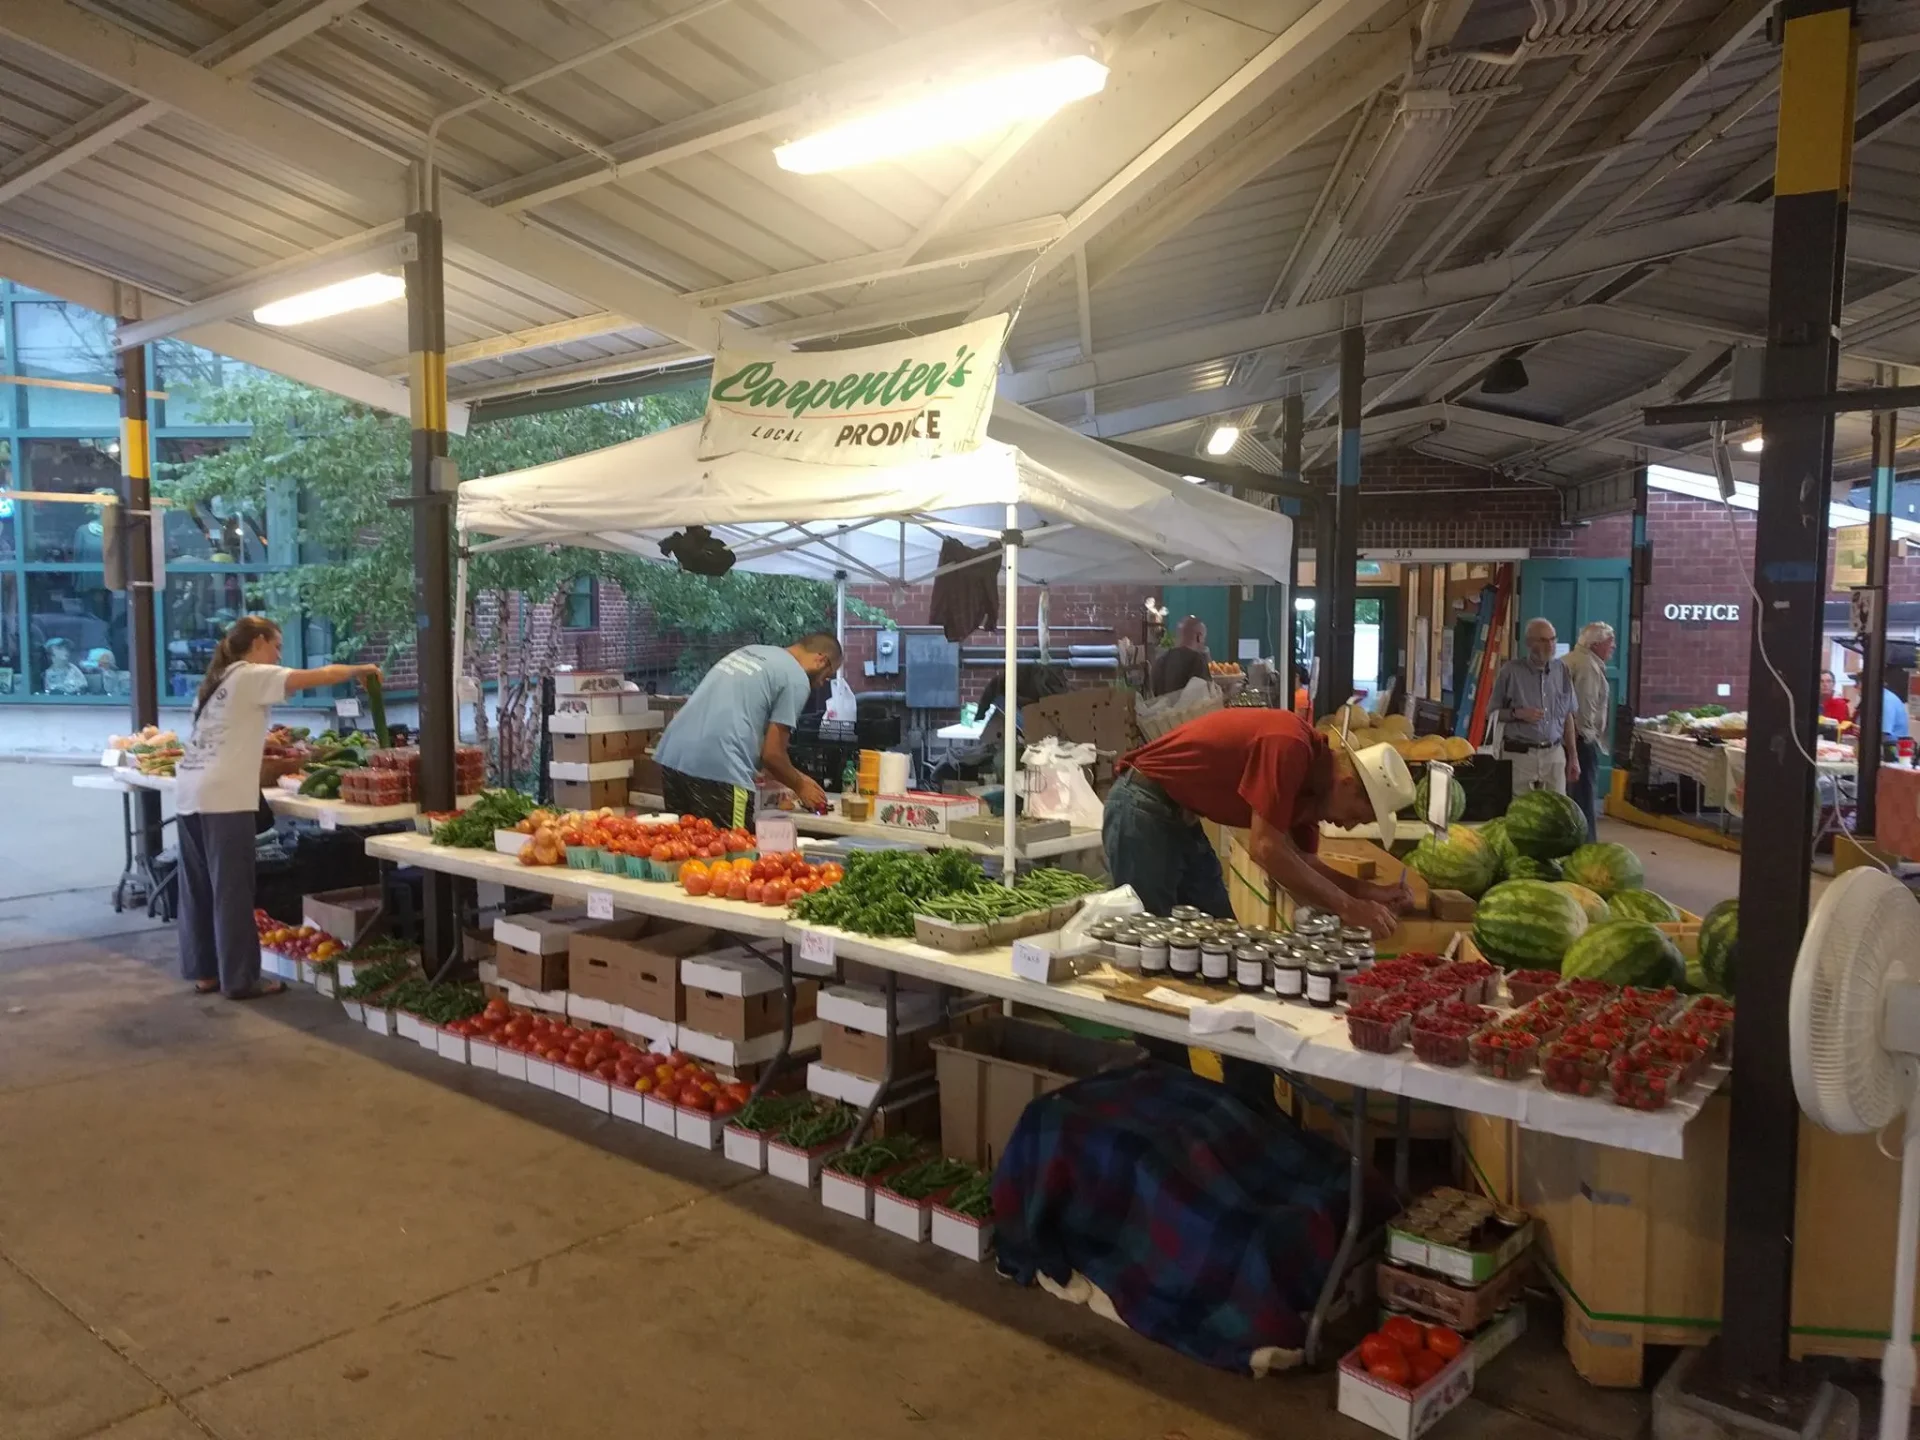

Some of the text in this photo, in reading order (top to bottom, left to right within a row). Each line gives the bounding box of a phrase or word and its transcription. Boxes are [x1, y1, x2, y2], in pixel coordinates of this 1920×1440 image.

[711, 344, 976, 419] Carpenter's
[751, 425, 803, 443] LOCAL
[1663, 603, 1740, 621] OFFICE
